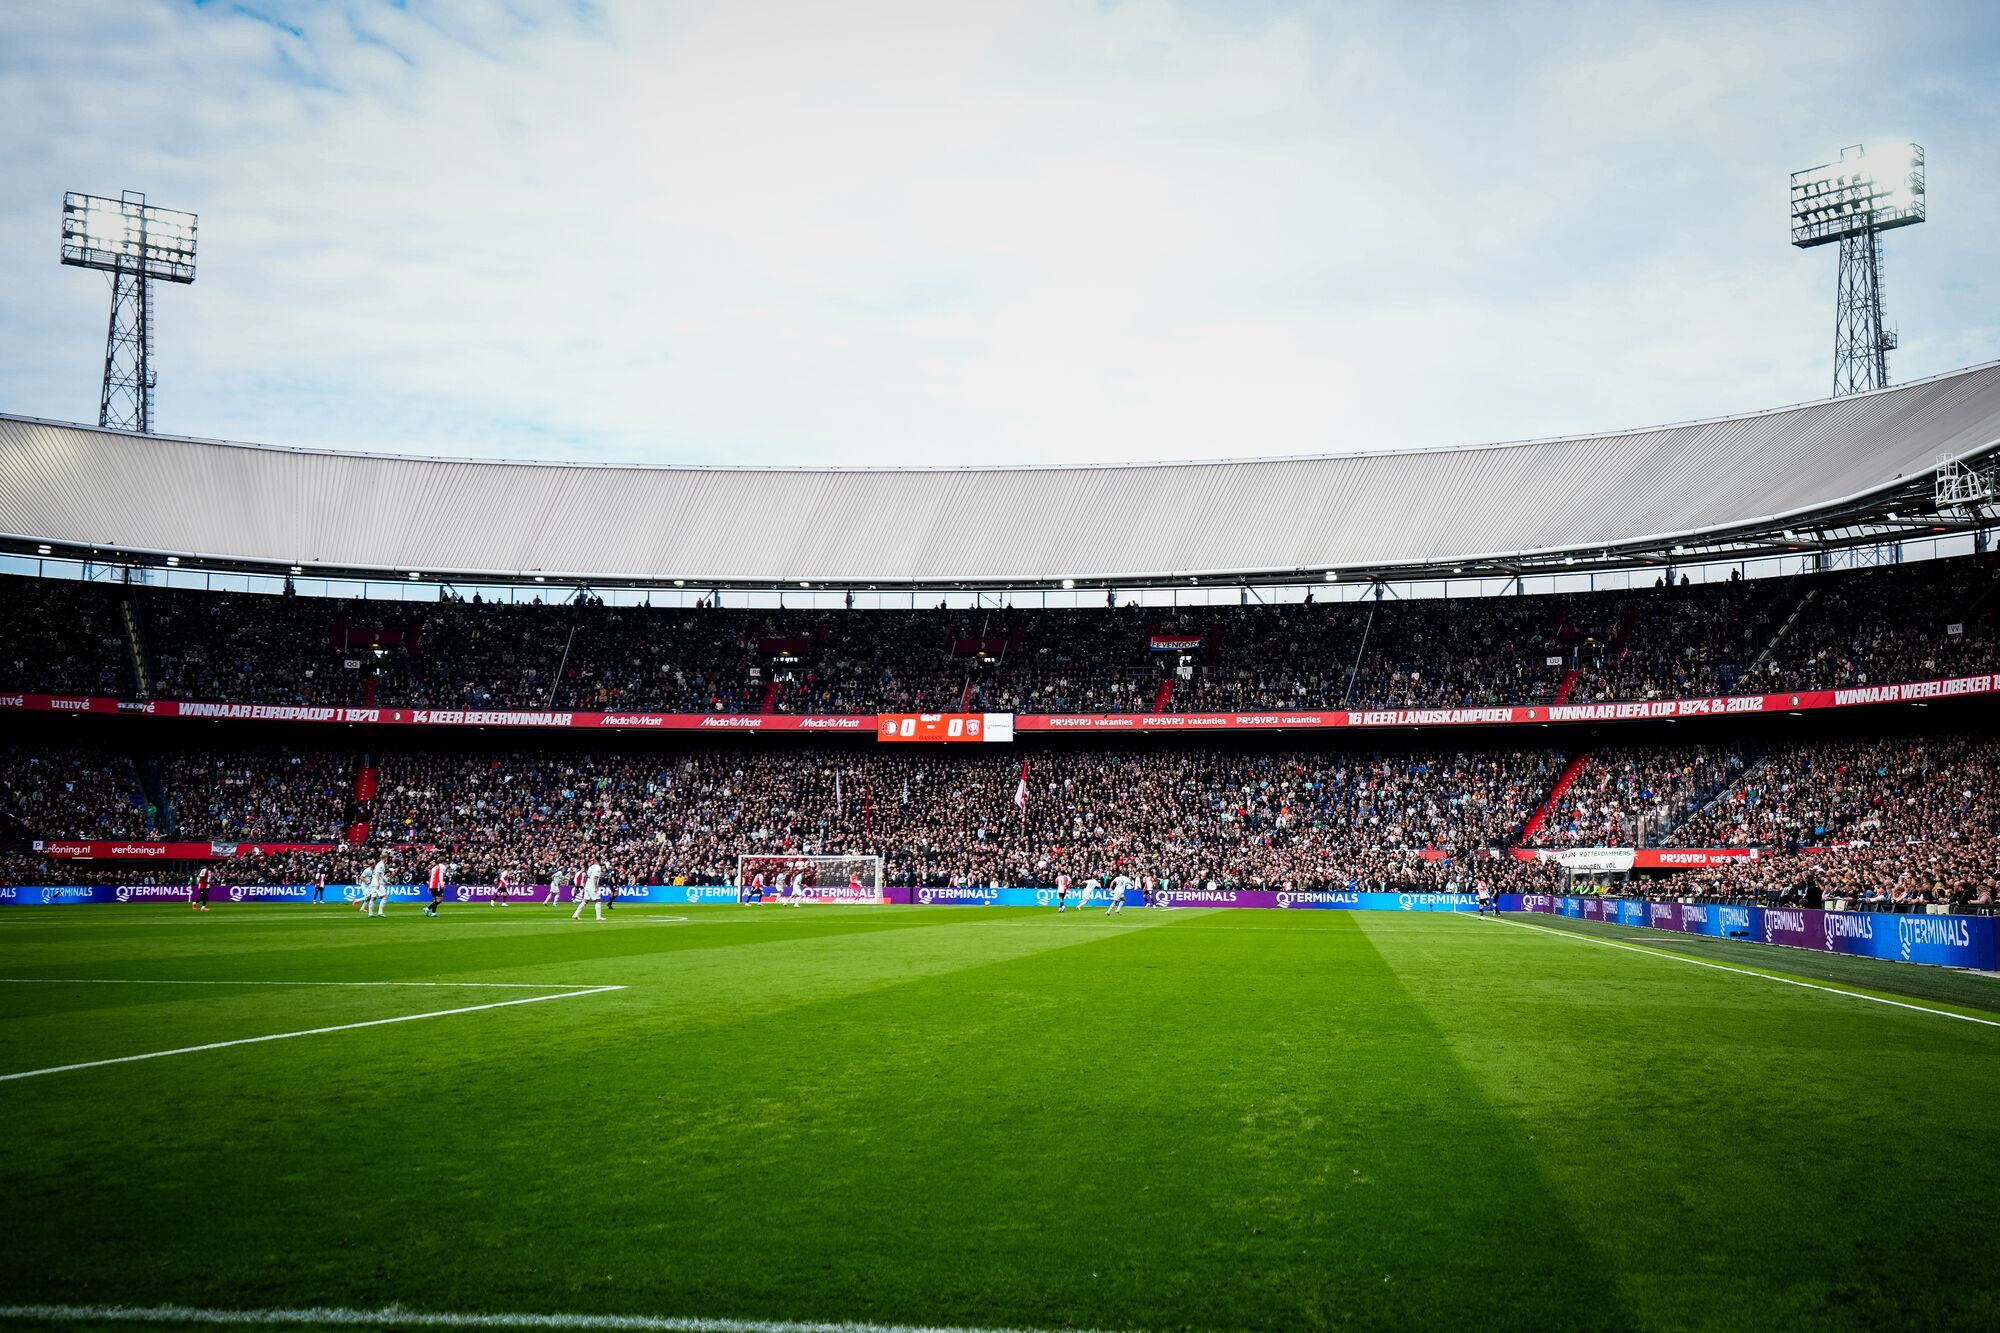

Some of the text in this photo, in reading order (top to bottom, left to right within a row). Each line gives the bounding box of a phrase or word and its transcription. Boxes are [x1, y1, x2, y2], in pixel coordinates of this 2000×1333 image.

[1834, 685, 1899, 705] WINNAAR
[1900, 675, 1991, 699] WERELDBEKER
[178, 702, 380, 722] WINNAAR EUROPACUP 1 1970
[1348, 709, 1512, 725] 16 KEER LANDSKAMPIOEN
[1549, 696, 1763, 720] WINNAAR UEFA CUP 1974 & 2002
[413, 710, 573, 726] 14 KEER BEKERWINNAAR
[1094, 717, 1133, 726] vakanties
[1188, 716, 1226, 725] vakanties
[1281, 715, 1321, 724] vakanties
[900, 718, 963, 737] 0 0
[111, 844, 166, 856] verloning.nl
[116, 885, 193, 902] QTERMINALS
[230, 886, 306, 902] QTERMINALS
[918, 888, 998, 904] QTERMINALS
[1155, 890, 1237, 908] QTERMINALS
[1276, 891, 1359, 909] QTERMINALS
[1718, 905, 1749, 936] QTERMINALS
[1764, 908, 1804, 943] QTERMINALS
[1824, 912, 1872, 950] QTERMINALS
[1898, 915, 1969, 960] QTERMINALS
